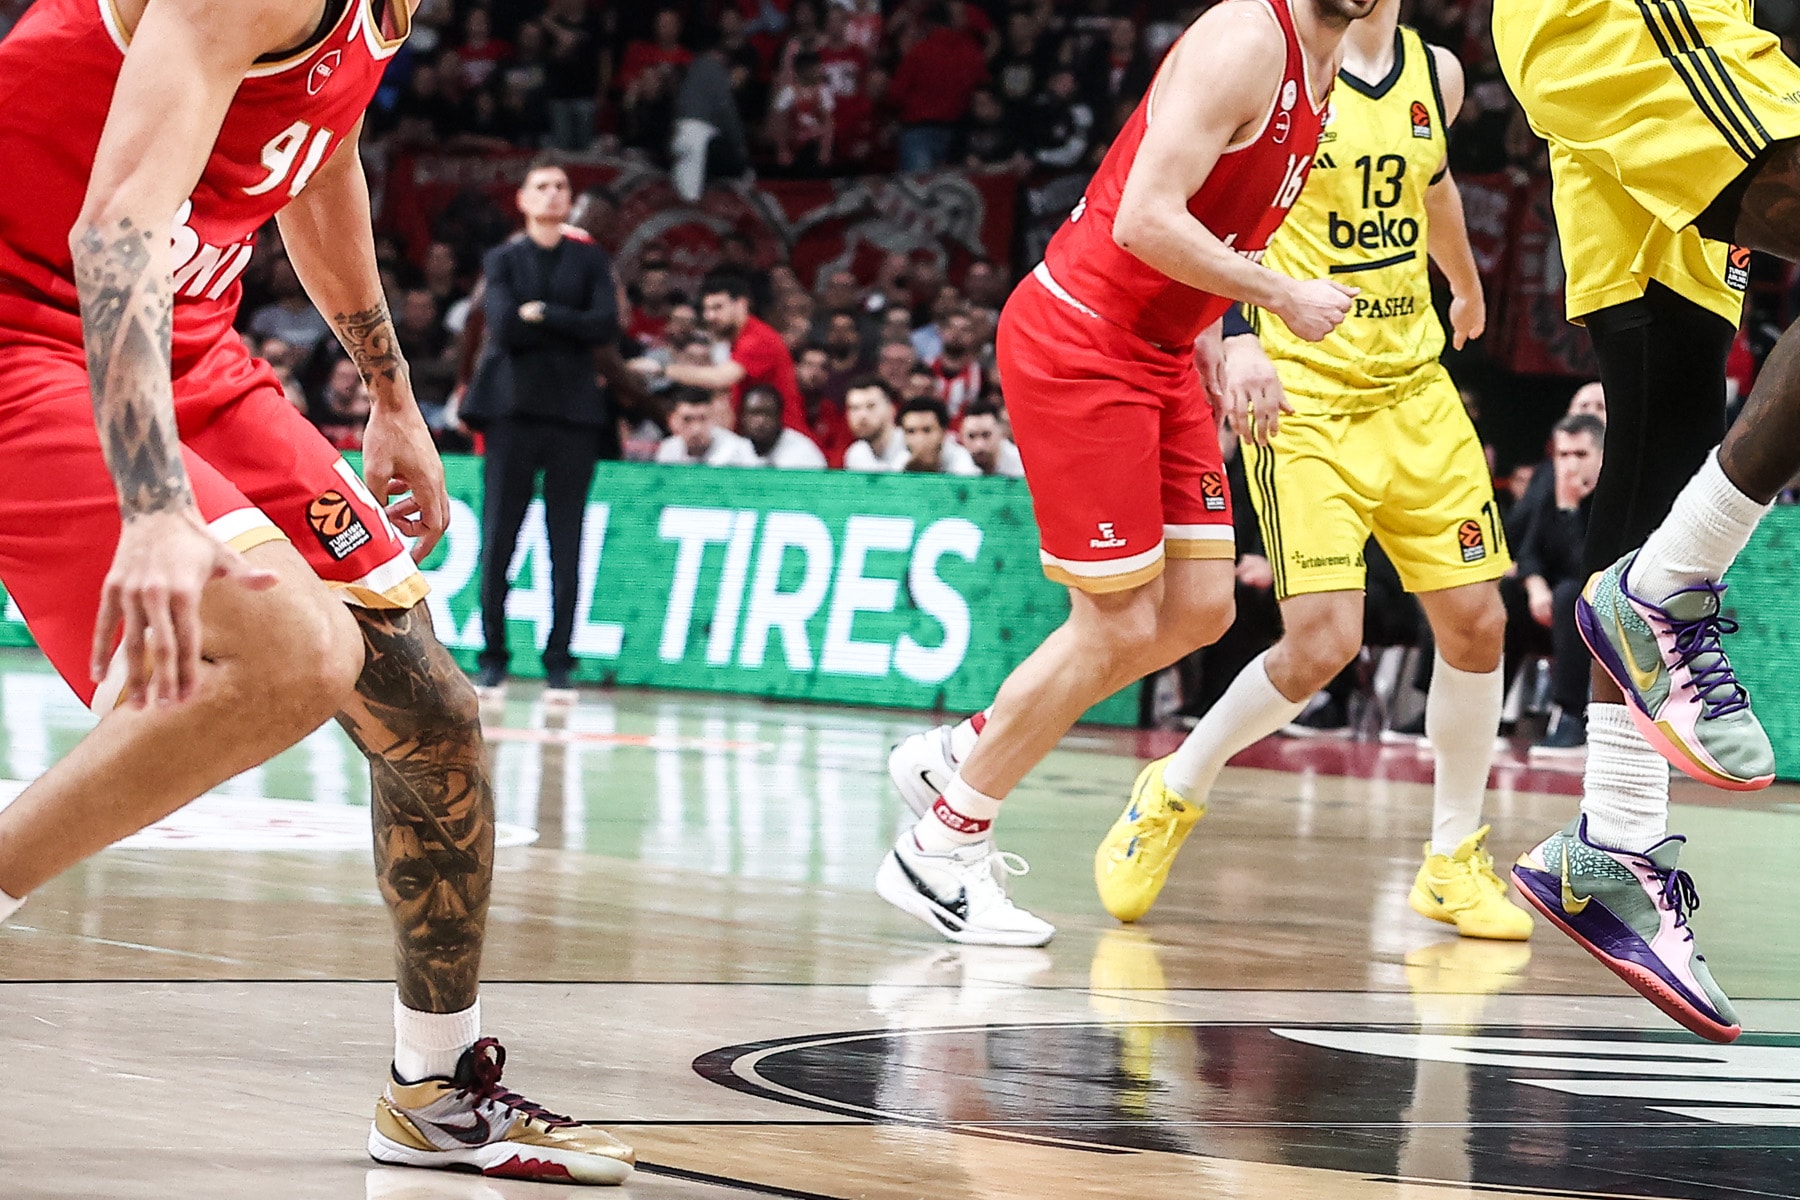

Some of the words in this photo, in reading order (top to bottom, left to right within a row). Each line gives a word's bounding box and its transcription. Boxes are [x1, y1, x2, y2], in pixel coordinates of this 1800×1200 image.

[241, 119, 333, 199] 91
[1271, 153, 1311, 209] 16
[1355, 154, 1406, 209] 13
[1329, 211, 1418, 249] beko
[1354, 296, 1415, 318] PASHA
[657, 504, 984, 684] TIRES
[936, 803, 981, 833] GSA
